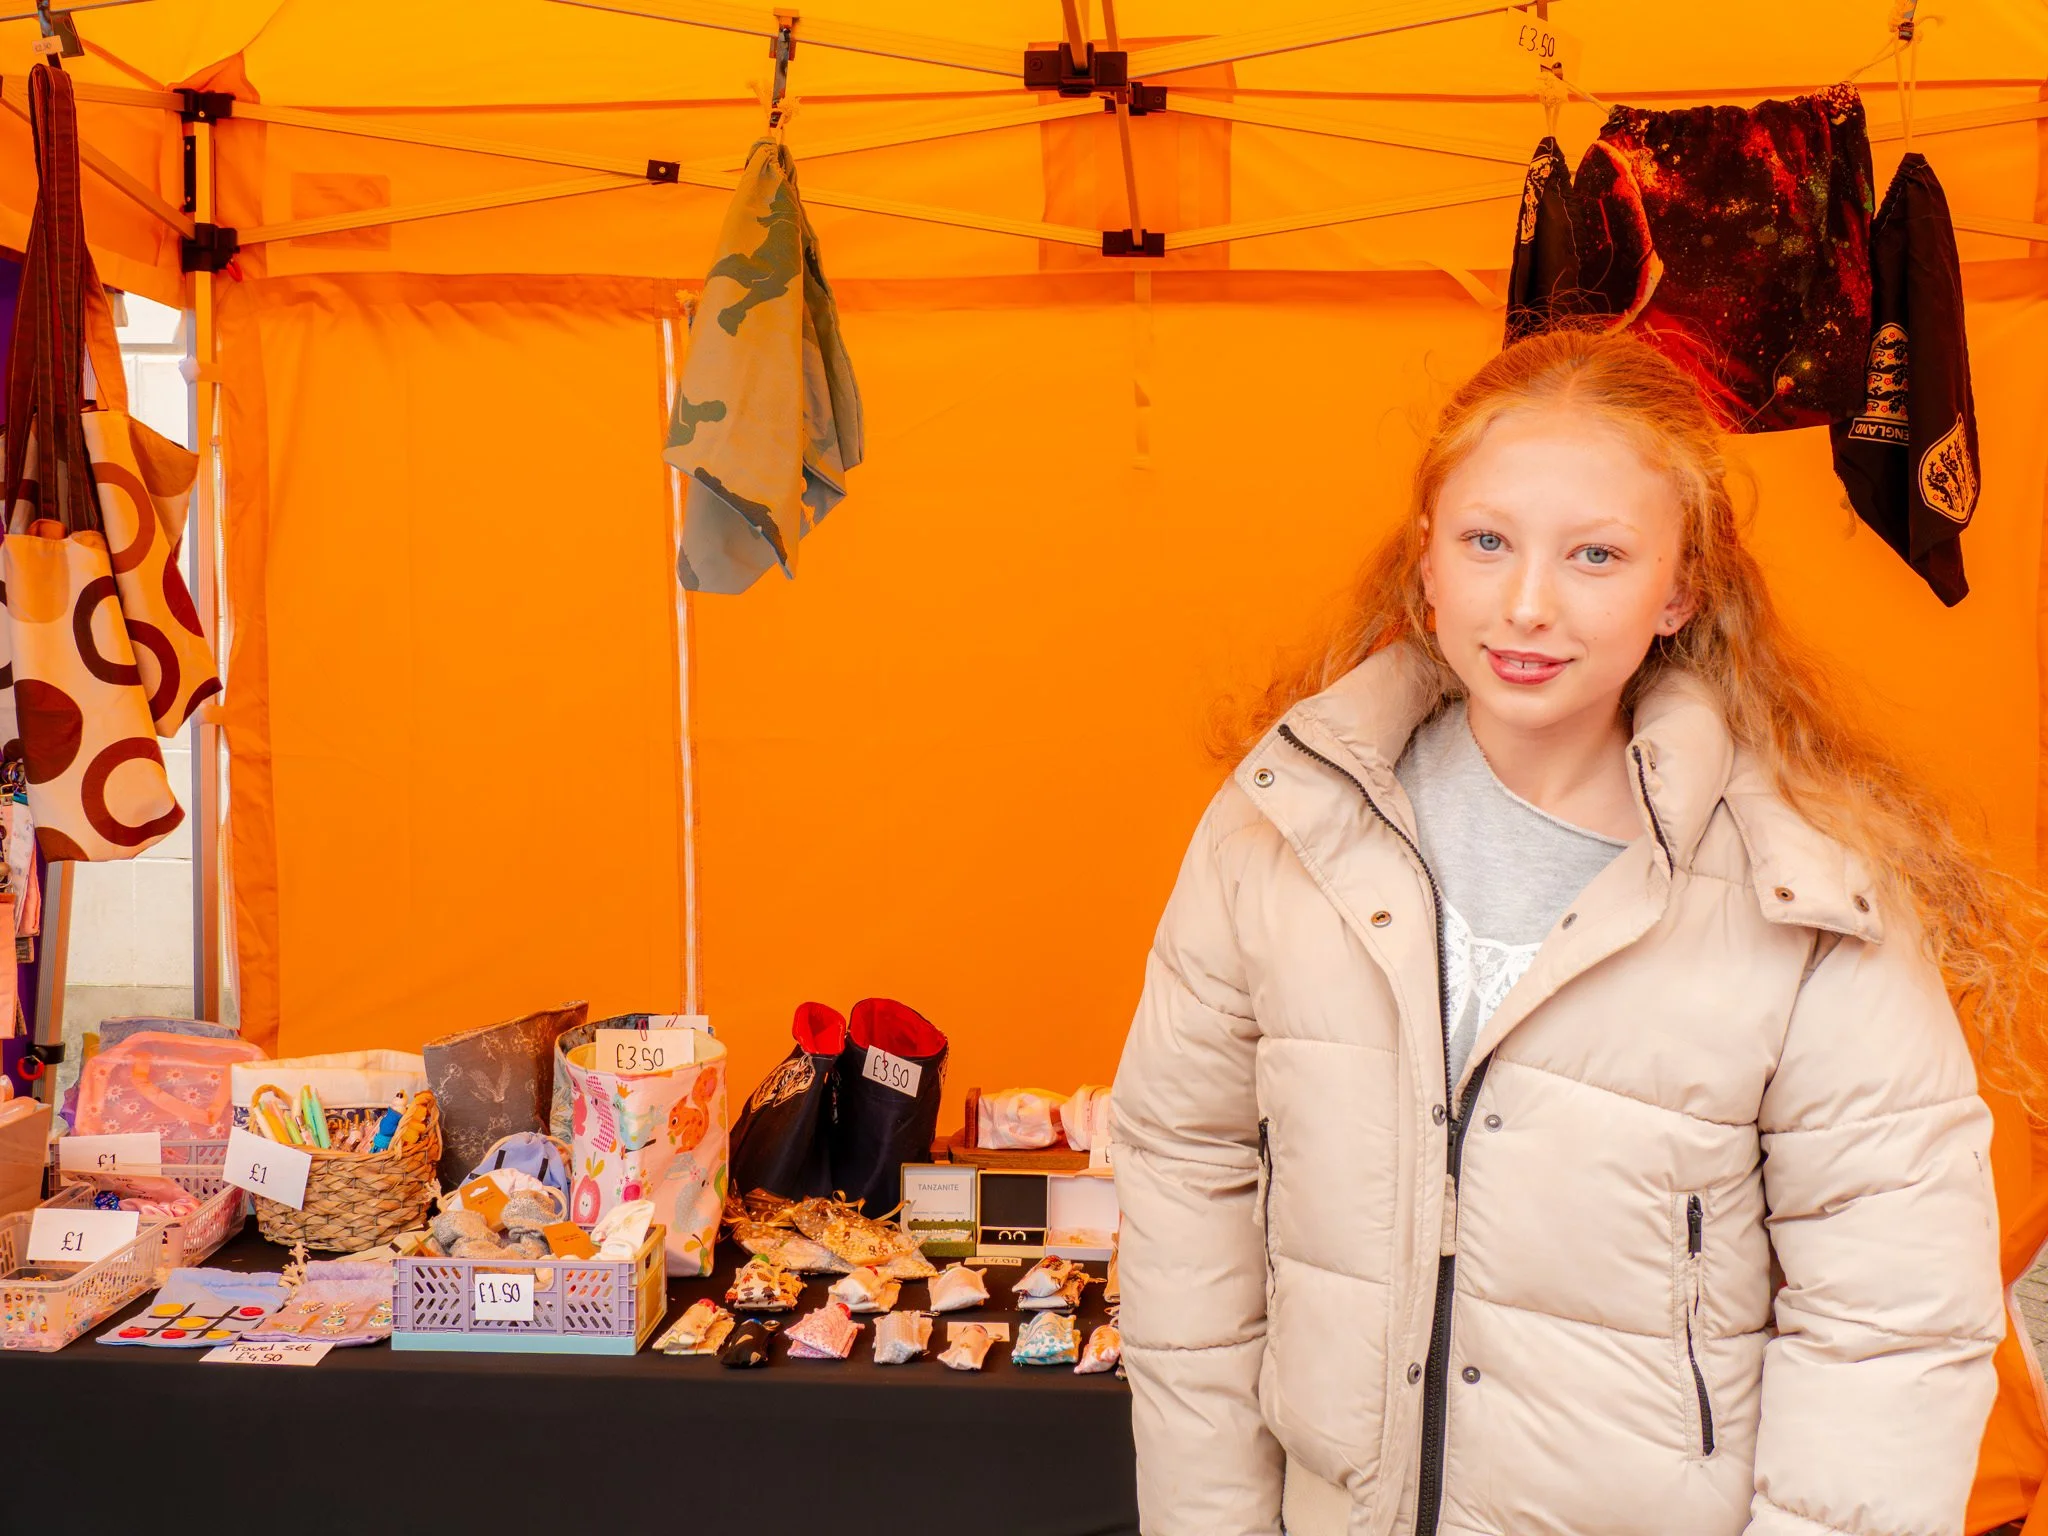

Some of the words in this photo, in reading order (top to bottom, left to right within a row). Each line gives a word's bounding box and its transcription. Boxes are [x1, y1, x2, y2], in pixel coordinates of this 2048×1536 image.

[1518, 24, 1555, 58] £3.50
[1855, 423, 1909, 441] ENGLAND
[616, 1043, 664, 1072] £3.50
[872, 1054, 910, 1089] £3.50
[248, 1163, 268, 1185] £1
[917, 1183, 960, 1191] TANZANITE
[60, 1231, 84, 1252] £1
[478, 1282, 521, 1303] £1.50
